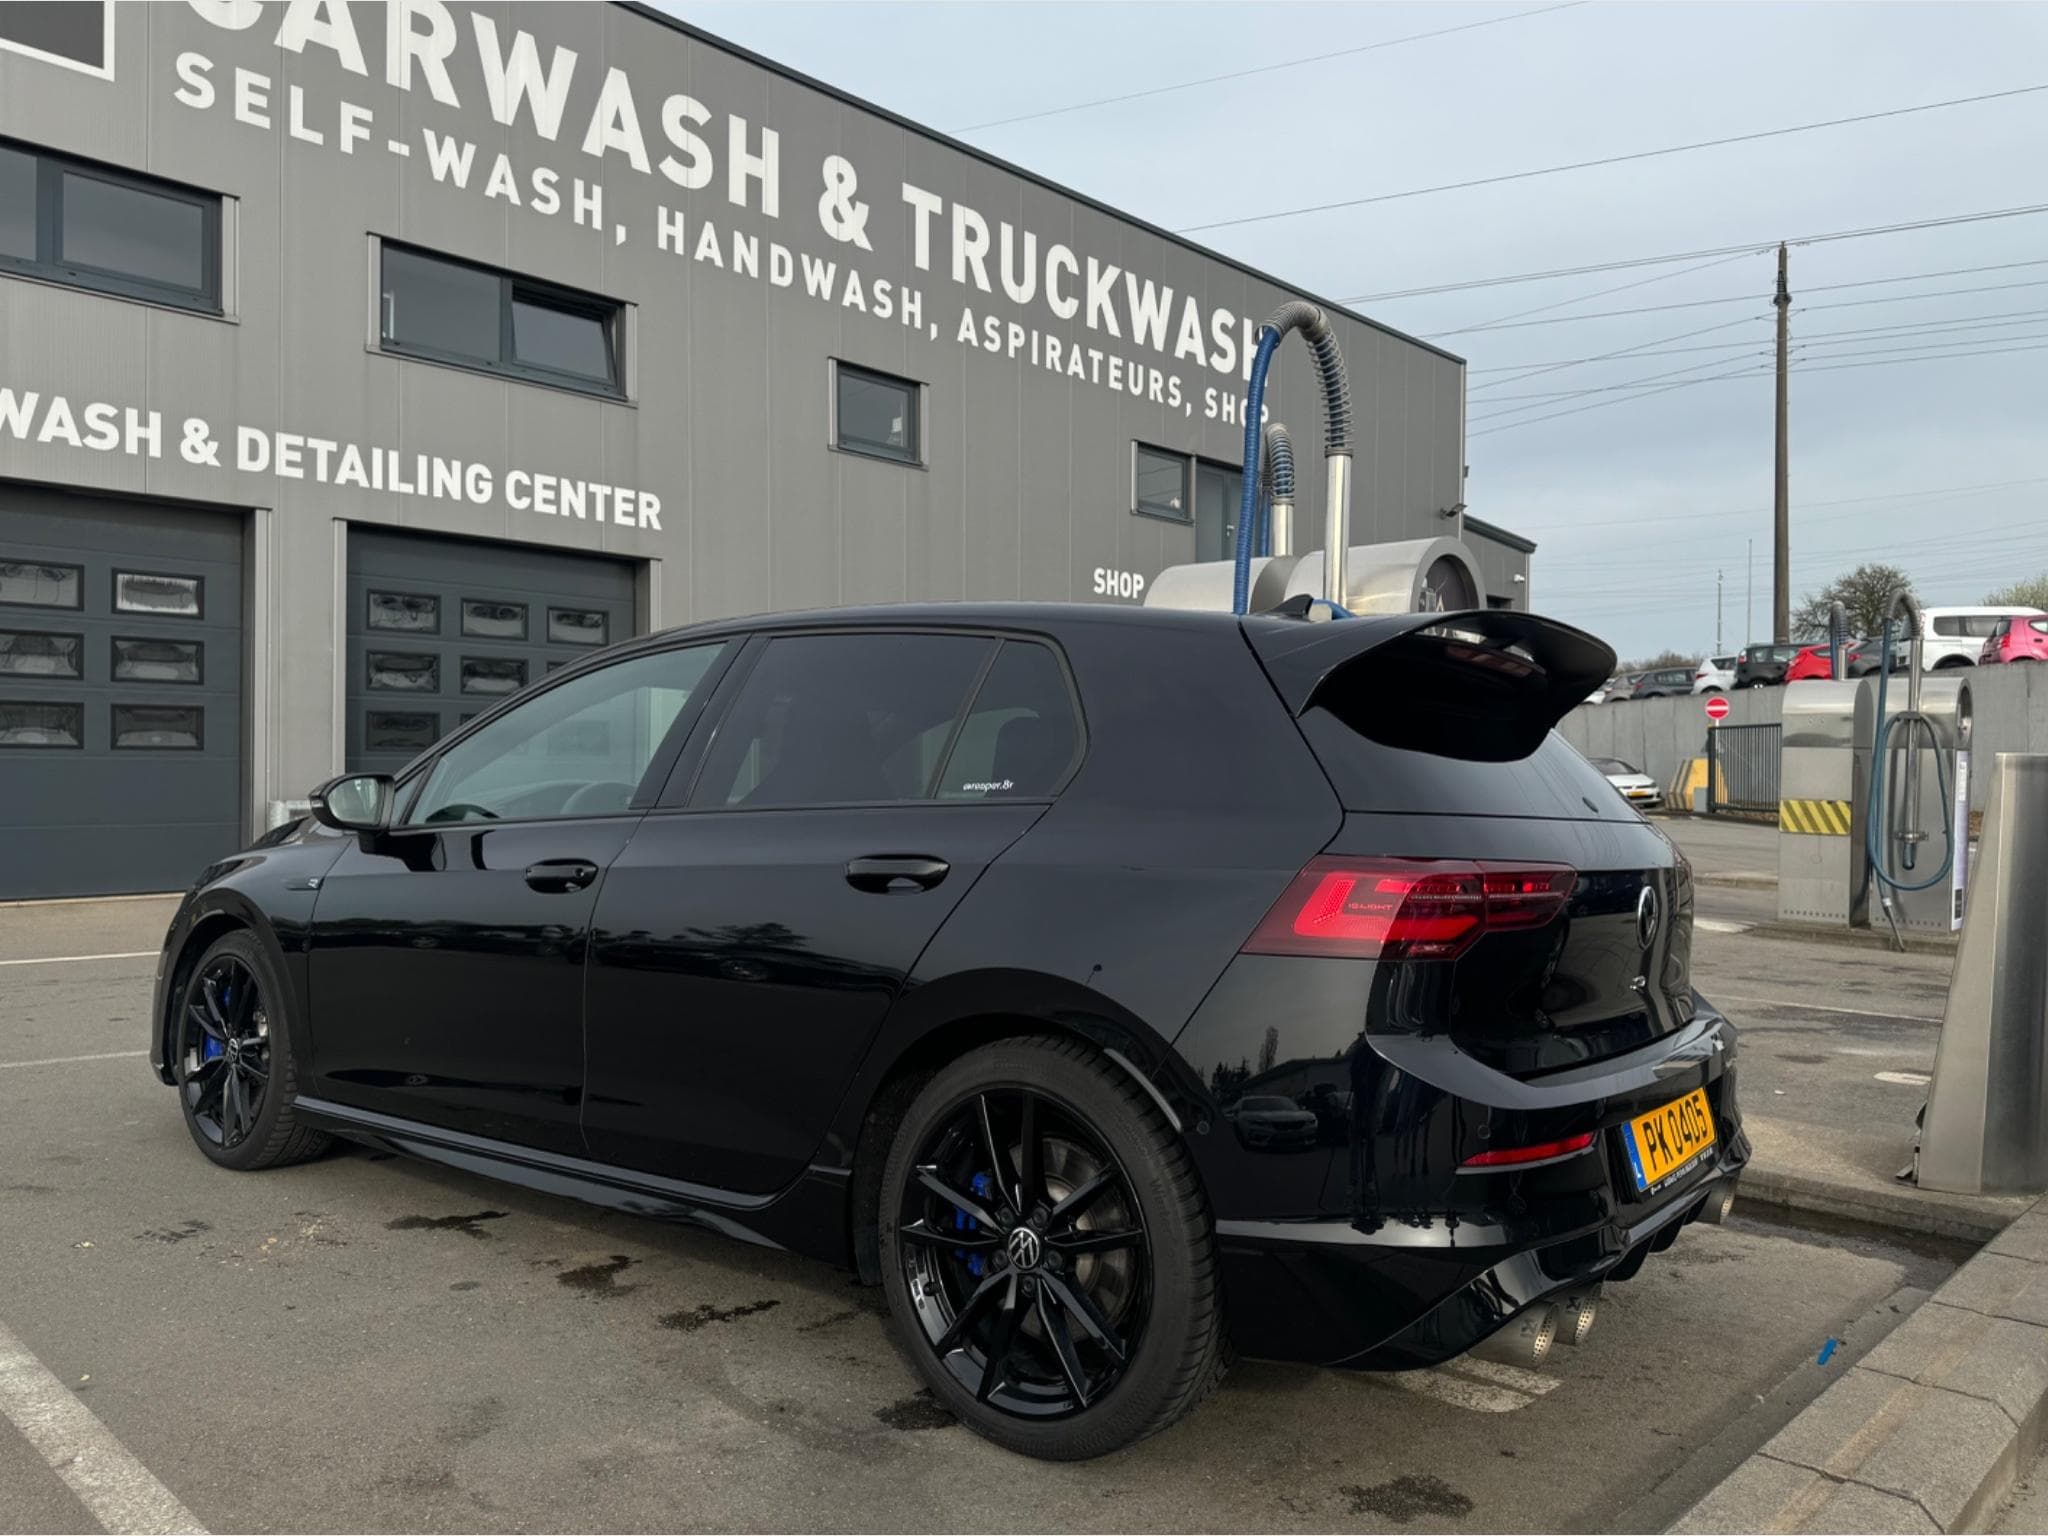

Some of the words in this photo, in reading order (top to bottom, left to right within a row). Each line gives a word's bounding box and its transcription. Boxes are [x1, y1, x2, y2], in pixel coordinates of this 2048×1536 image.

[187, 0, 779, 218] ARWASH
[818, 155, 873, 251] &
[173, 52, 627, 247] SELF-WASH,
[657, 205, 939, 341] HANDWASH,
[957, 307, 1193, 417] ASPIRATEURS,
[180, 418, 221, 467] &
[237, 425, 493, 504] DETAILING
[505, 470, 662, 531] CENTER
[1093, 567, 1144, 599] SHOP
[1642, 1113, 1674, 1172] PK
[1667, 1094, 1708, 1156] 0405
